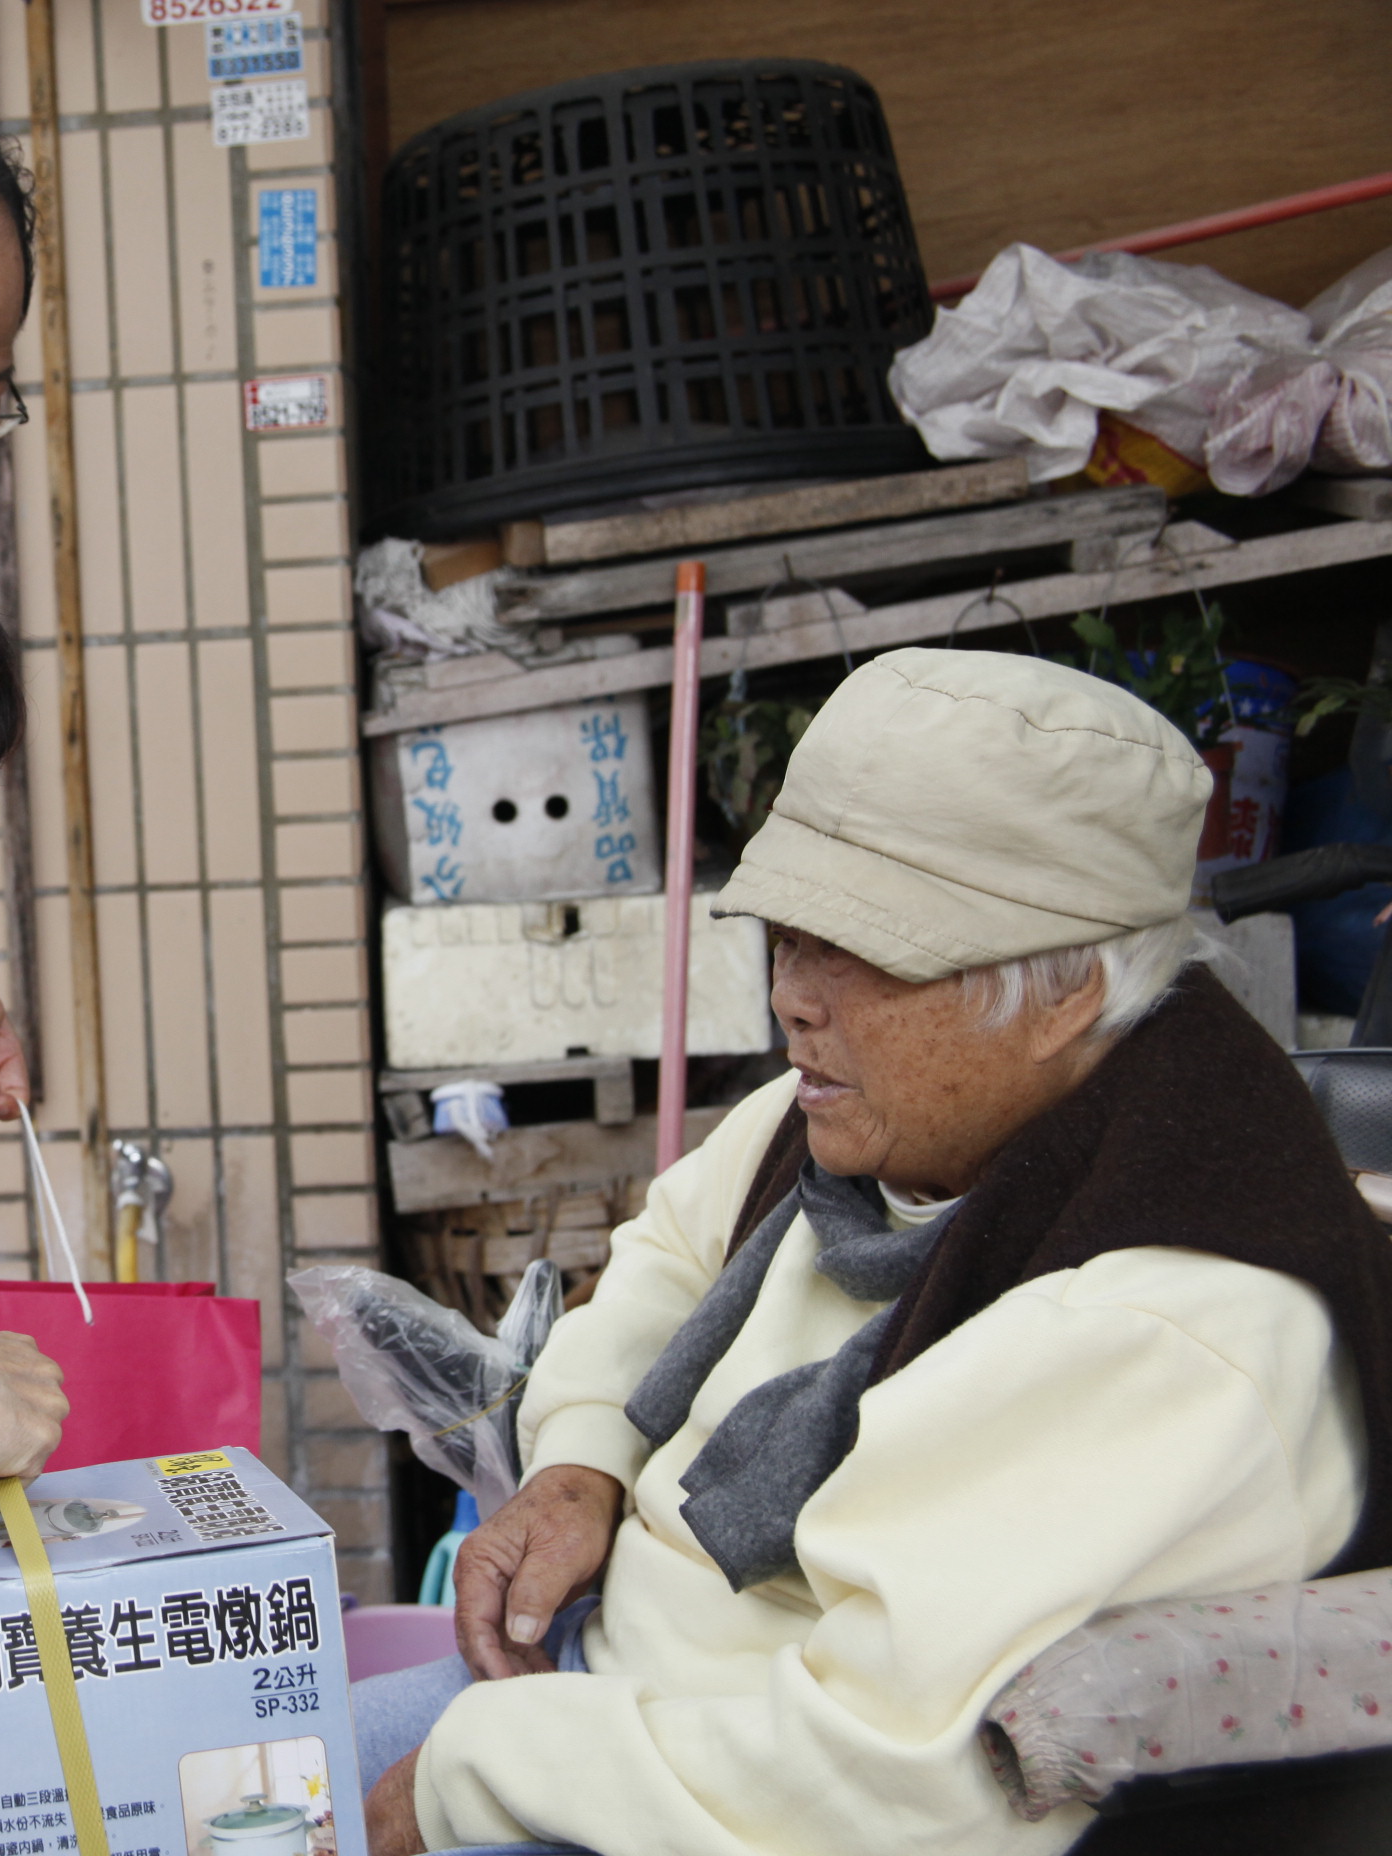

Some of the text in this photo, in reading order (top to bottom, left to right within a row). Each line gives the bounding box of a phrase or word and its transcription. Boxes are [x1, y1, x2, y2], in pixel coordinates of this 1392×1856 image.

[579, 697, 636, 884] 品質保
[253, 1662, 318, 1690] 2公升
[255, 1692, 320, 1718] SP-332
